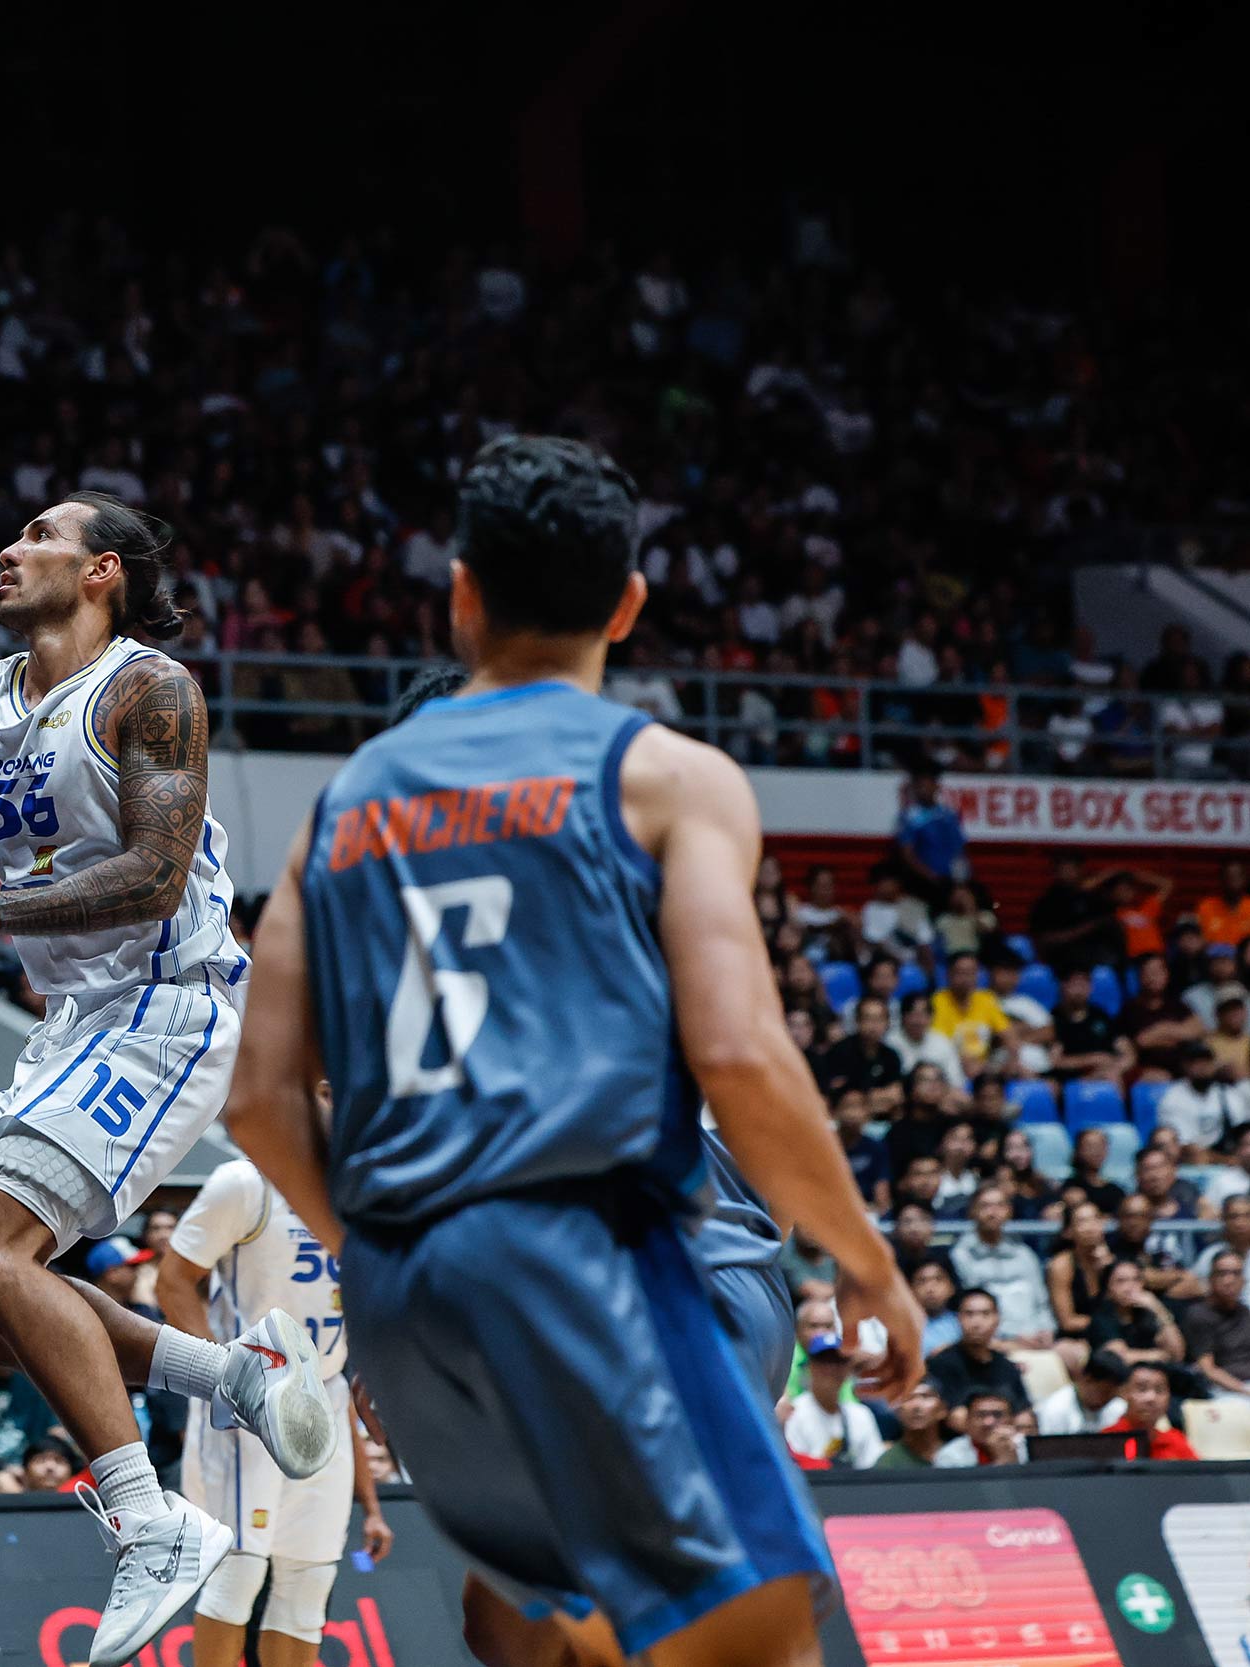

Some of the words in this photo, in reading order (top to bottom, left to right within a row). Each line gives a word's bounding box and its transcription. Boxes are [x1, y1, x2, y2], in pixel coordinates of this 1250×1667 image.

[940, 785, 1040, 828] WER
[1050, 786, 1134, 832] BOX
[385, 875, 513, 1098] 6
[76, 1061, 148, 1138] 15
